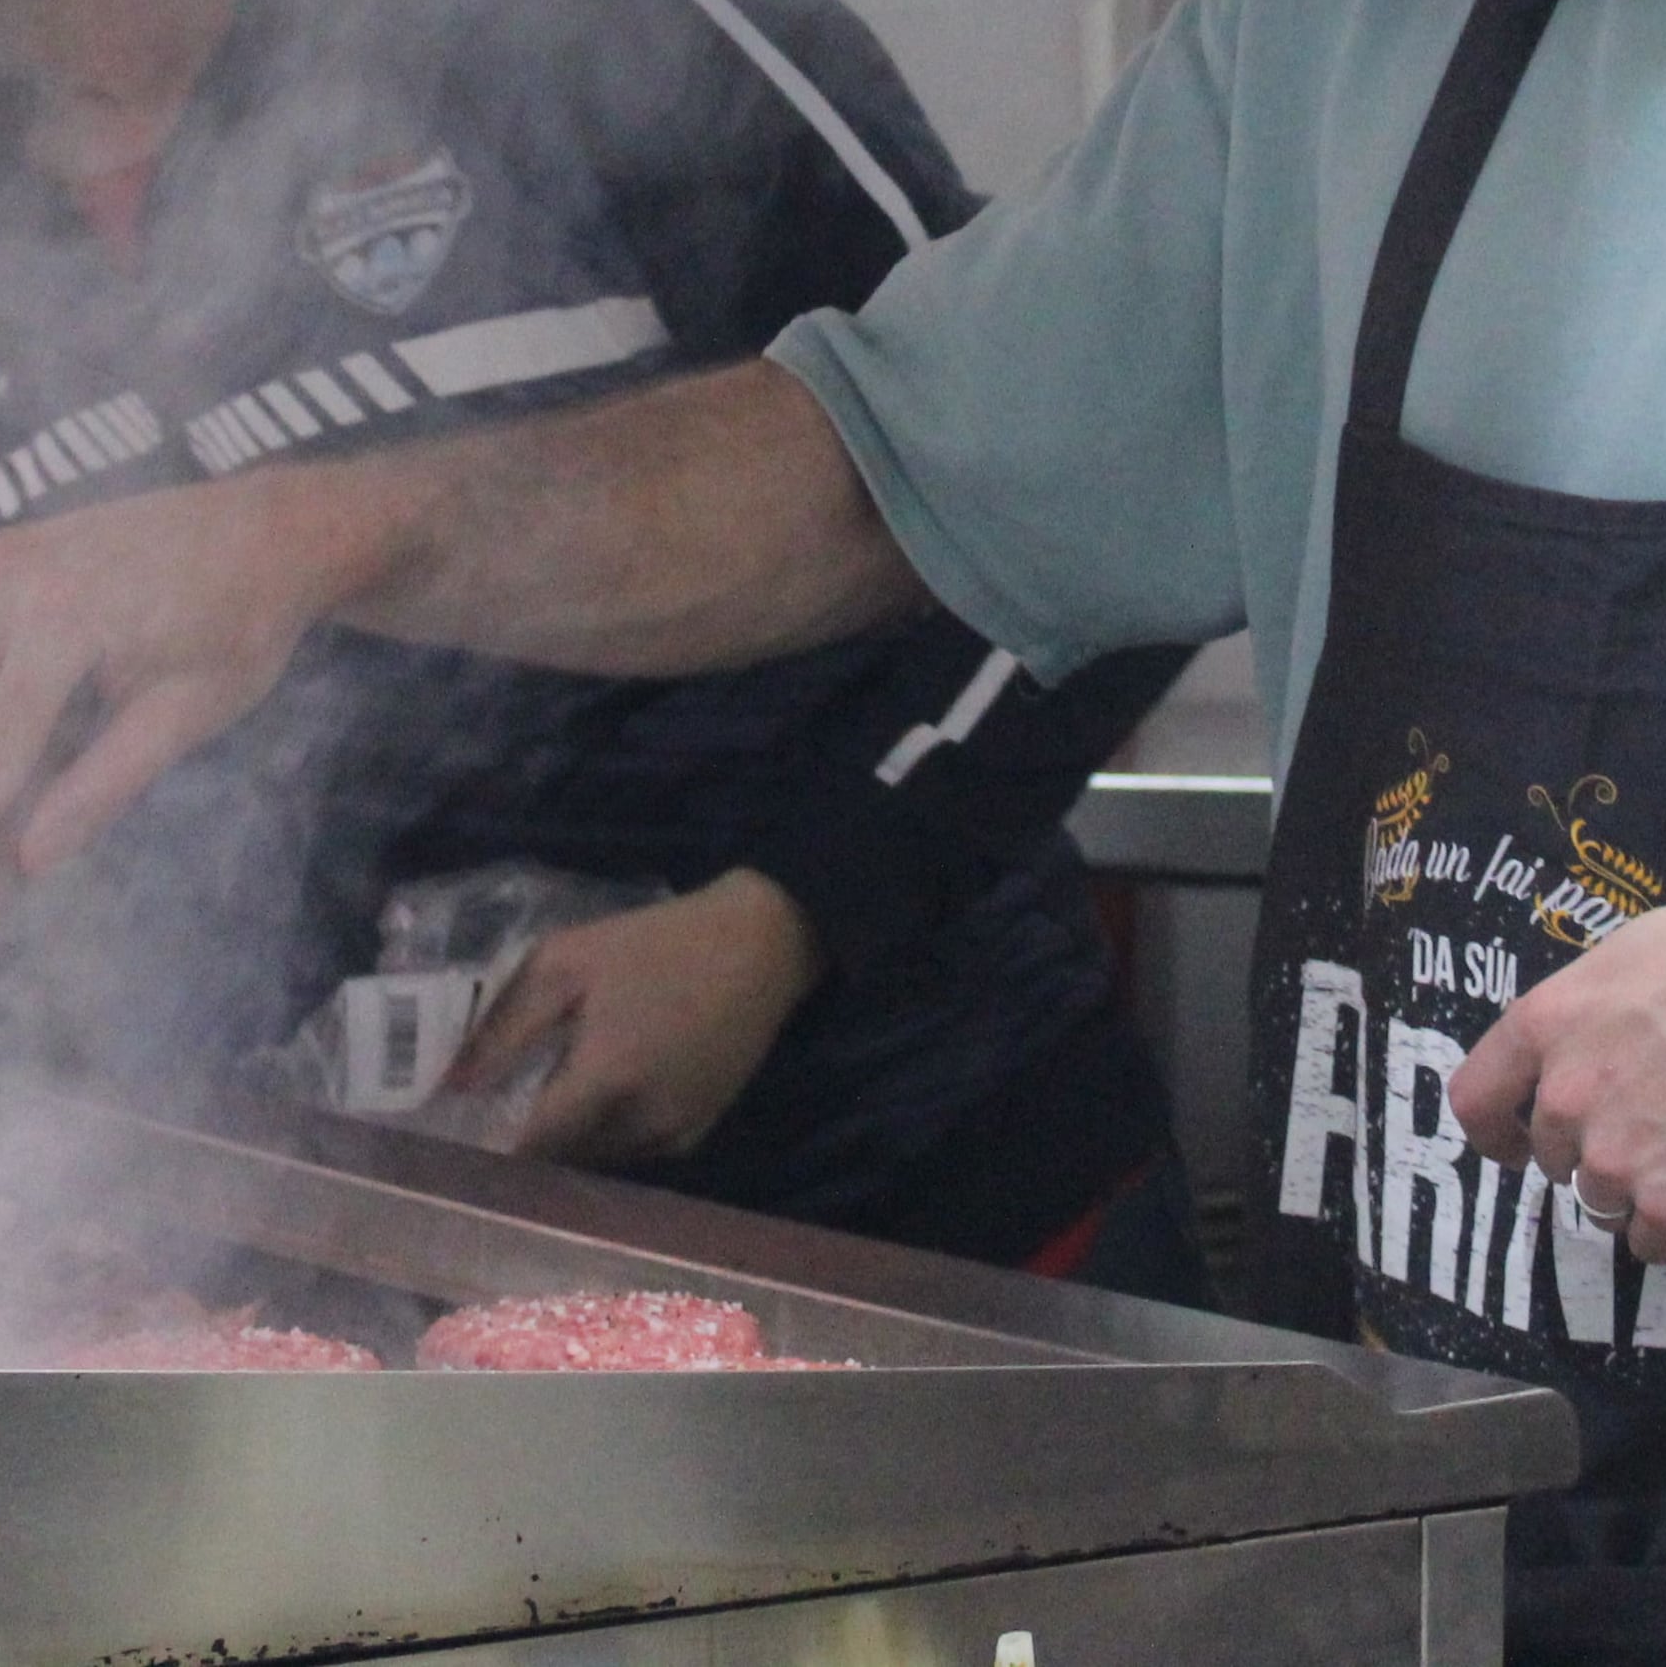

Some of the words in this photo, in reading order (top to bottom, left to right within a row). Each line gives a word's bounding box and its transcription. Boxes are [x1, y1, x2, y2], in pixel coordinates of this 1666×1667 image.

[1425, 840, 1471, 883] un
[1473, 833, 1545, 902] fai
[1408, 927, 1455, 994] DA
[1464, 936, 1518, 1011] SÚA
